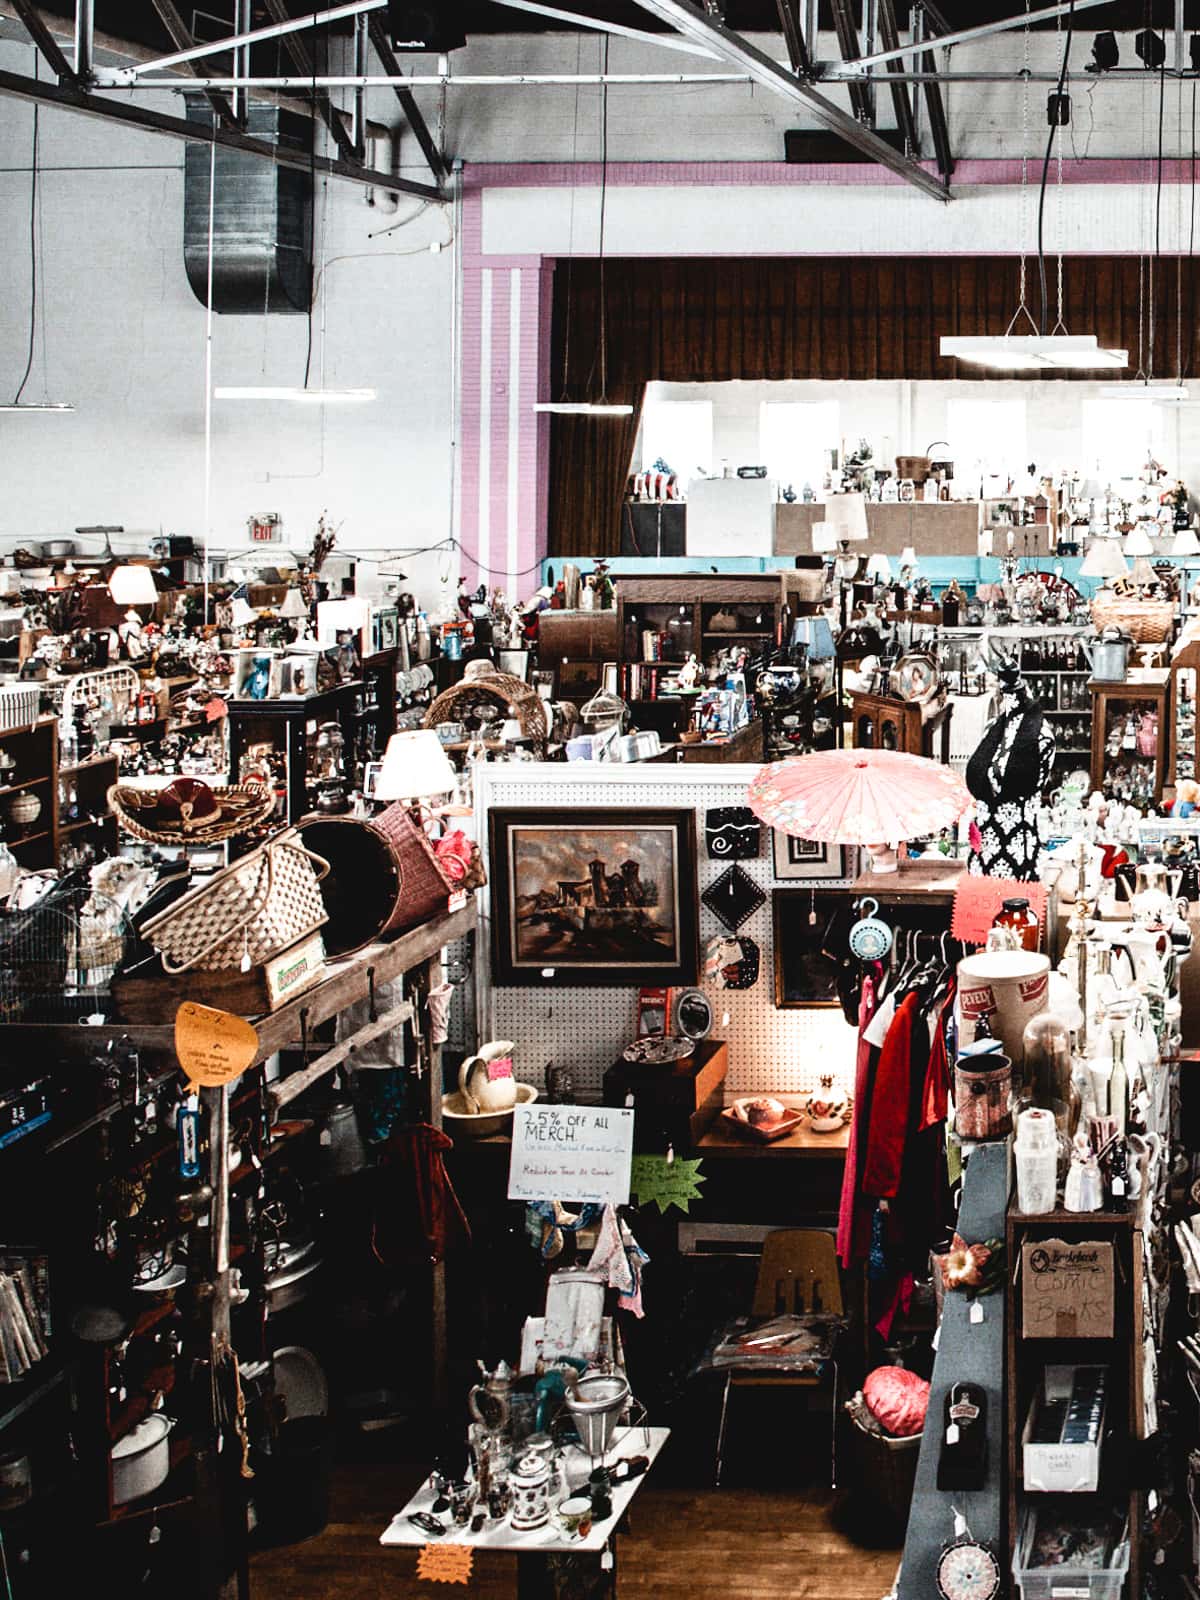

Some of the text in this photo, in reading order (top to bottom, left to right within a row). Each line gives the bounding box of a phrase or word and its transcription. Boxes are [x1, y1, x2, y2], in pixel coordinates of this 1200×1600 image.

[254, 526, 272, 540] EXIT
[524, 1110, 561, 1126] 25%
[594, 1116, 609, 1130] ALL
